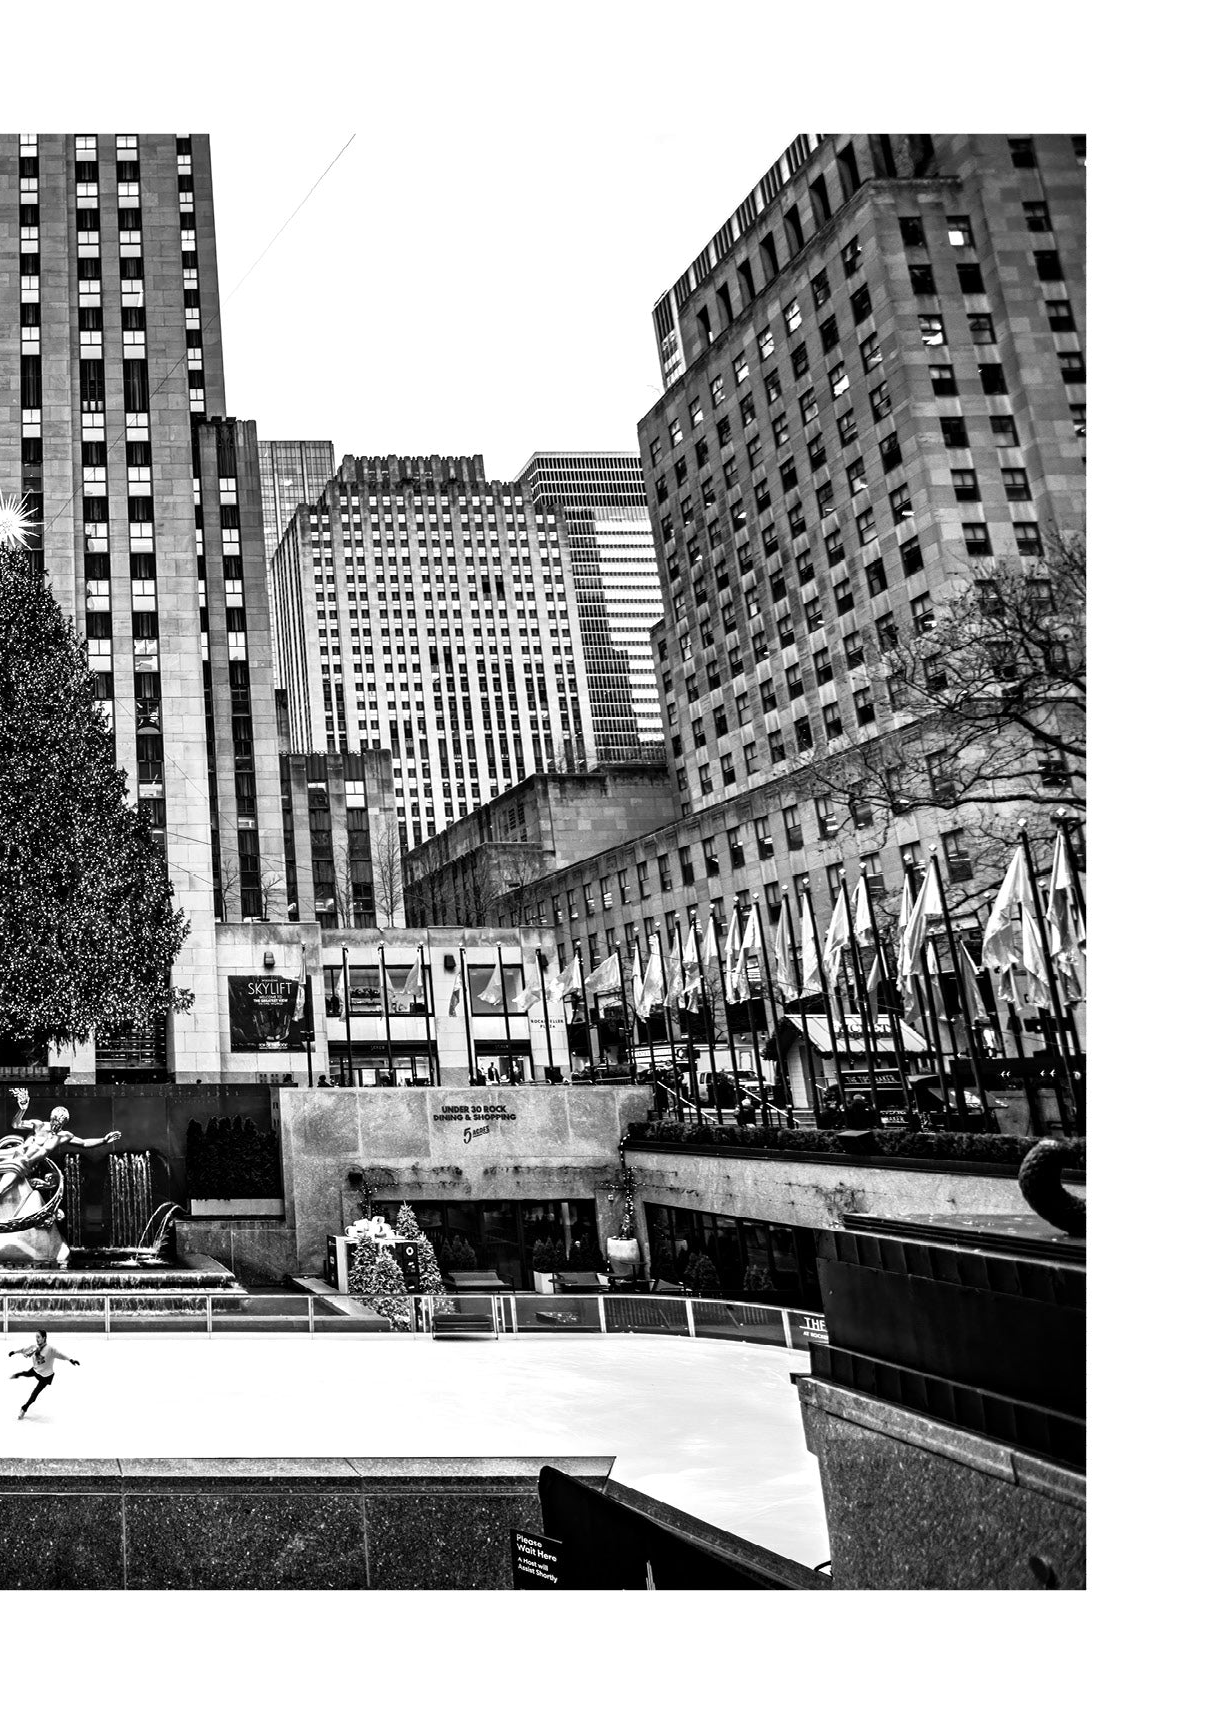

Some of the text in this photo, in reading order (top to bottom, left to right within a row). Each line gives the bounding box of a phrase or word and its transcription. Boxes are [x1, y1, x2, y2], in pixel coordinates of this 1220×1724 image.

[247, 982, 292, 995] SKYLIFT
[441, 1105, 507, 1114] UNDER 30 ROCK
[473, 1113, 517, 1121] SHOPPING
[463, 1125, 491, 1144] 5 ACRES
[803, 1316, 827, 1331] THE
[516, 1533, 543, 1548] Please
[516, 1543, 557, 1562] Wait Here
[523, 1558, 537, 1568] Host
[518, 1563, 558, 1584] Assist Shortly
